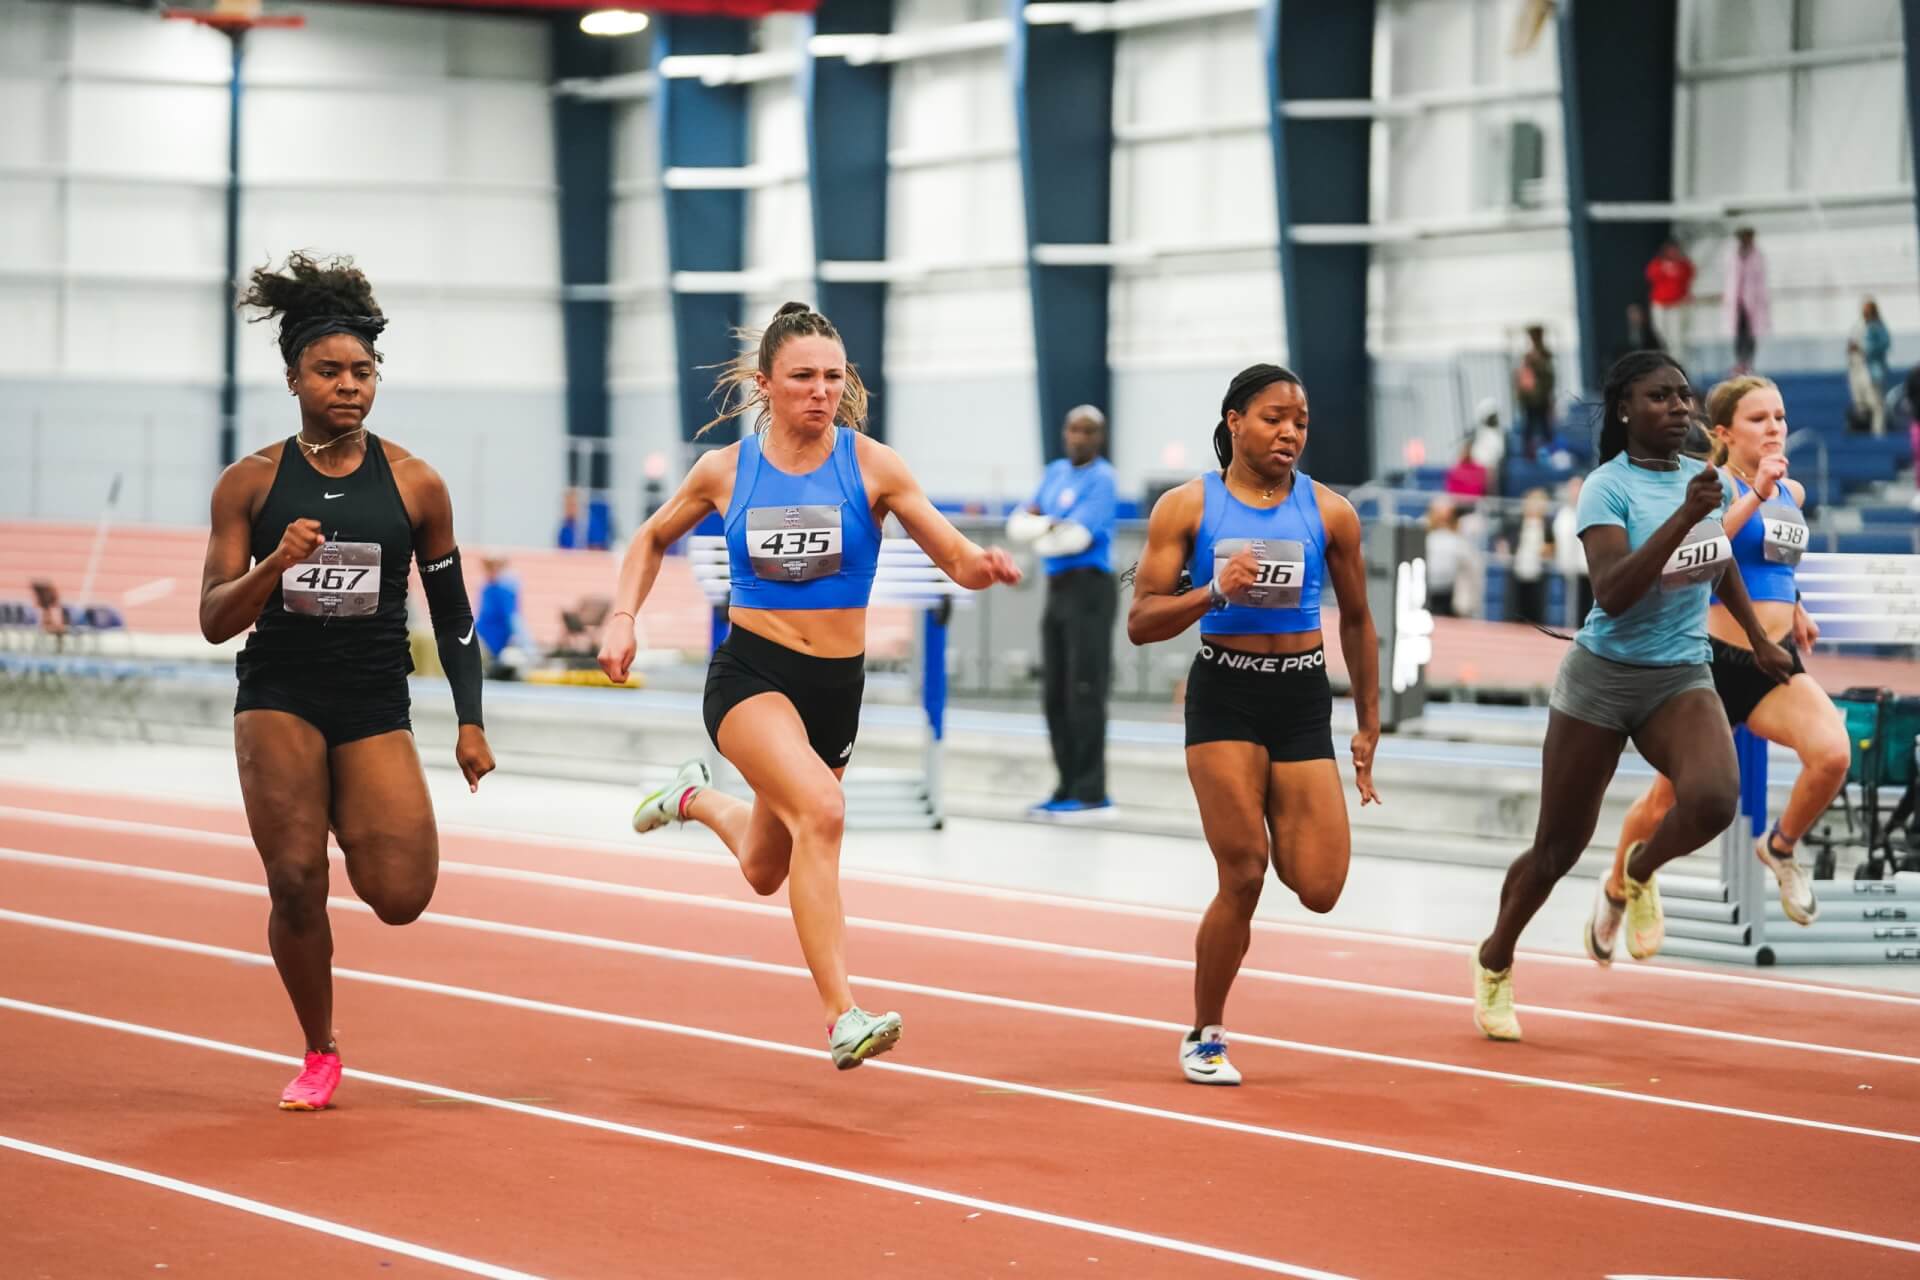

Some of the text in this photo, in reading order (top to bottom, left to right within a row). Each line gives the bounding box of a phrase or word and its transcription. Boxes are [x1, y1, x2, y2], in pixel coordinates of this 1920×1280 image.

[761, 531, 831, 555] 435
[1772, 523, 1804, 545] 438
[427, 556, 453, 573] NIKE
[1676, 542, 1718, 570] 510
[297, 567, 369, 590] 467
[1254, 564, 1294, 585] 36
[1217, 651, 1279, 673] NIKE
[1281, 650, 1323, 673] PRO
[1885, 948, 1920, 960] UC
